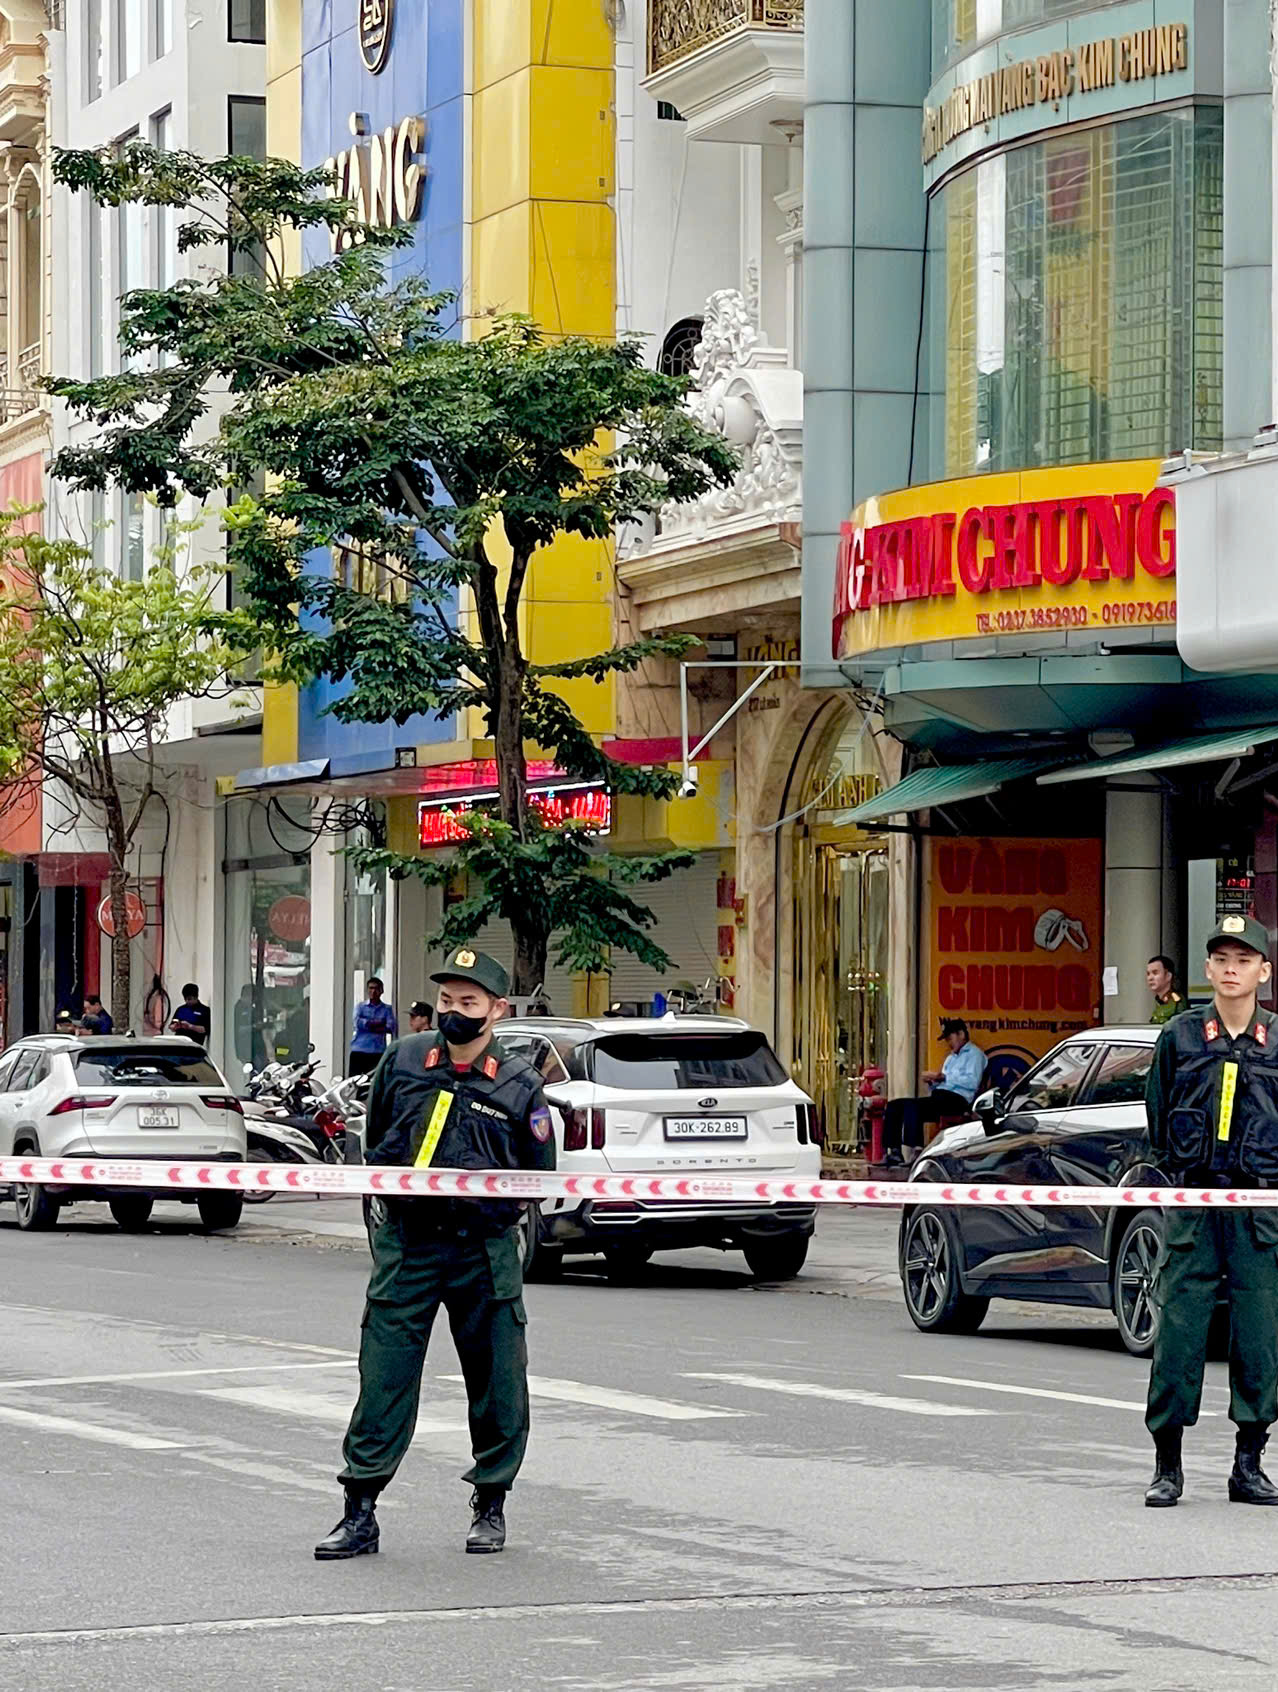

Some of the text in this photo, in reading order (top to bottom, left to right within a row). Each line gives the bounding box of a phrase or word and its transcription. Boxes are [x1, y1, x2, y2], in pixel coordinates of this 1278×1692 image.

[1035, 49, 1074, 112] BẠC
[1079, 37, 1115, 93] KIM
[1119, 23, 1187, 82] CHUNG
[957, 487, 1176, 594] CHUNG
[938, 906, 1034, 952] KIM
[938, 964, 1091, 1012] CHUNG
[674, 1121, 739, 1134] 30K-262.89
